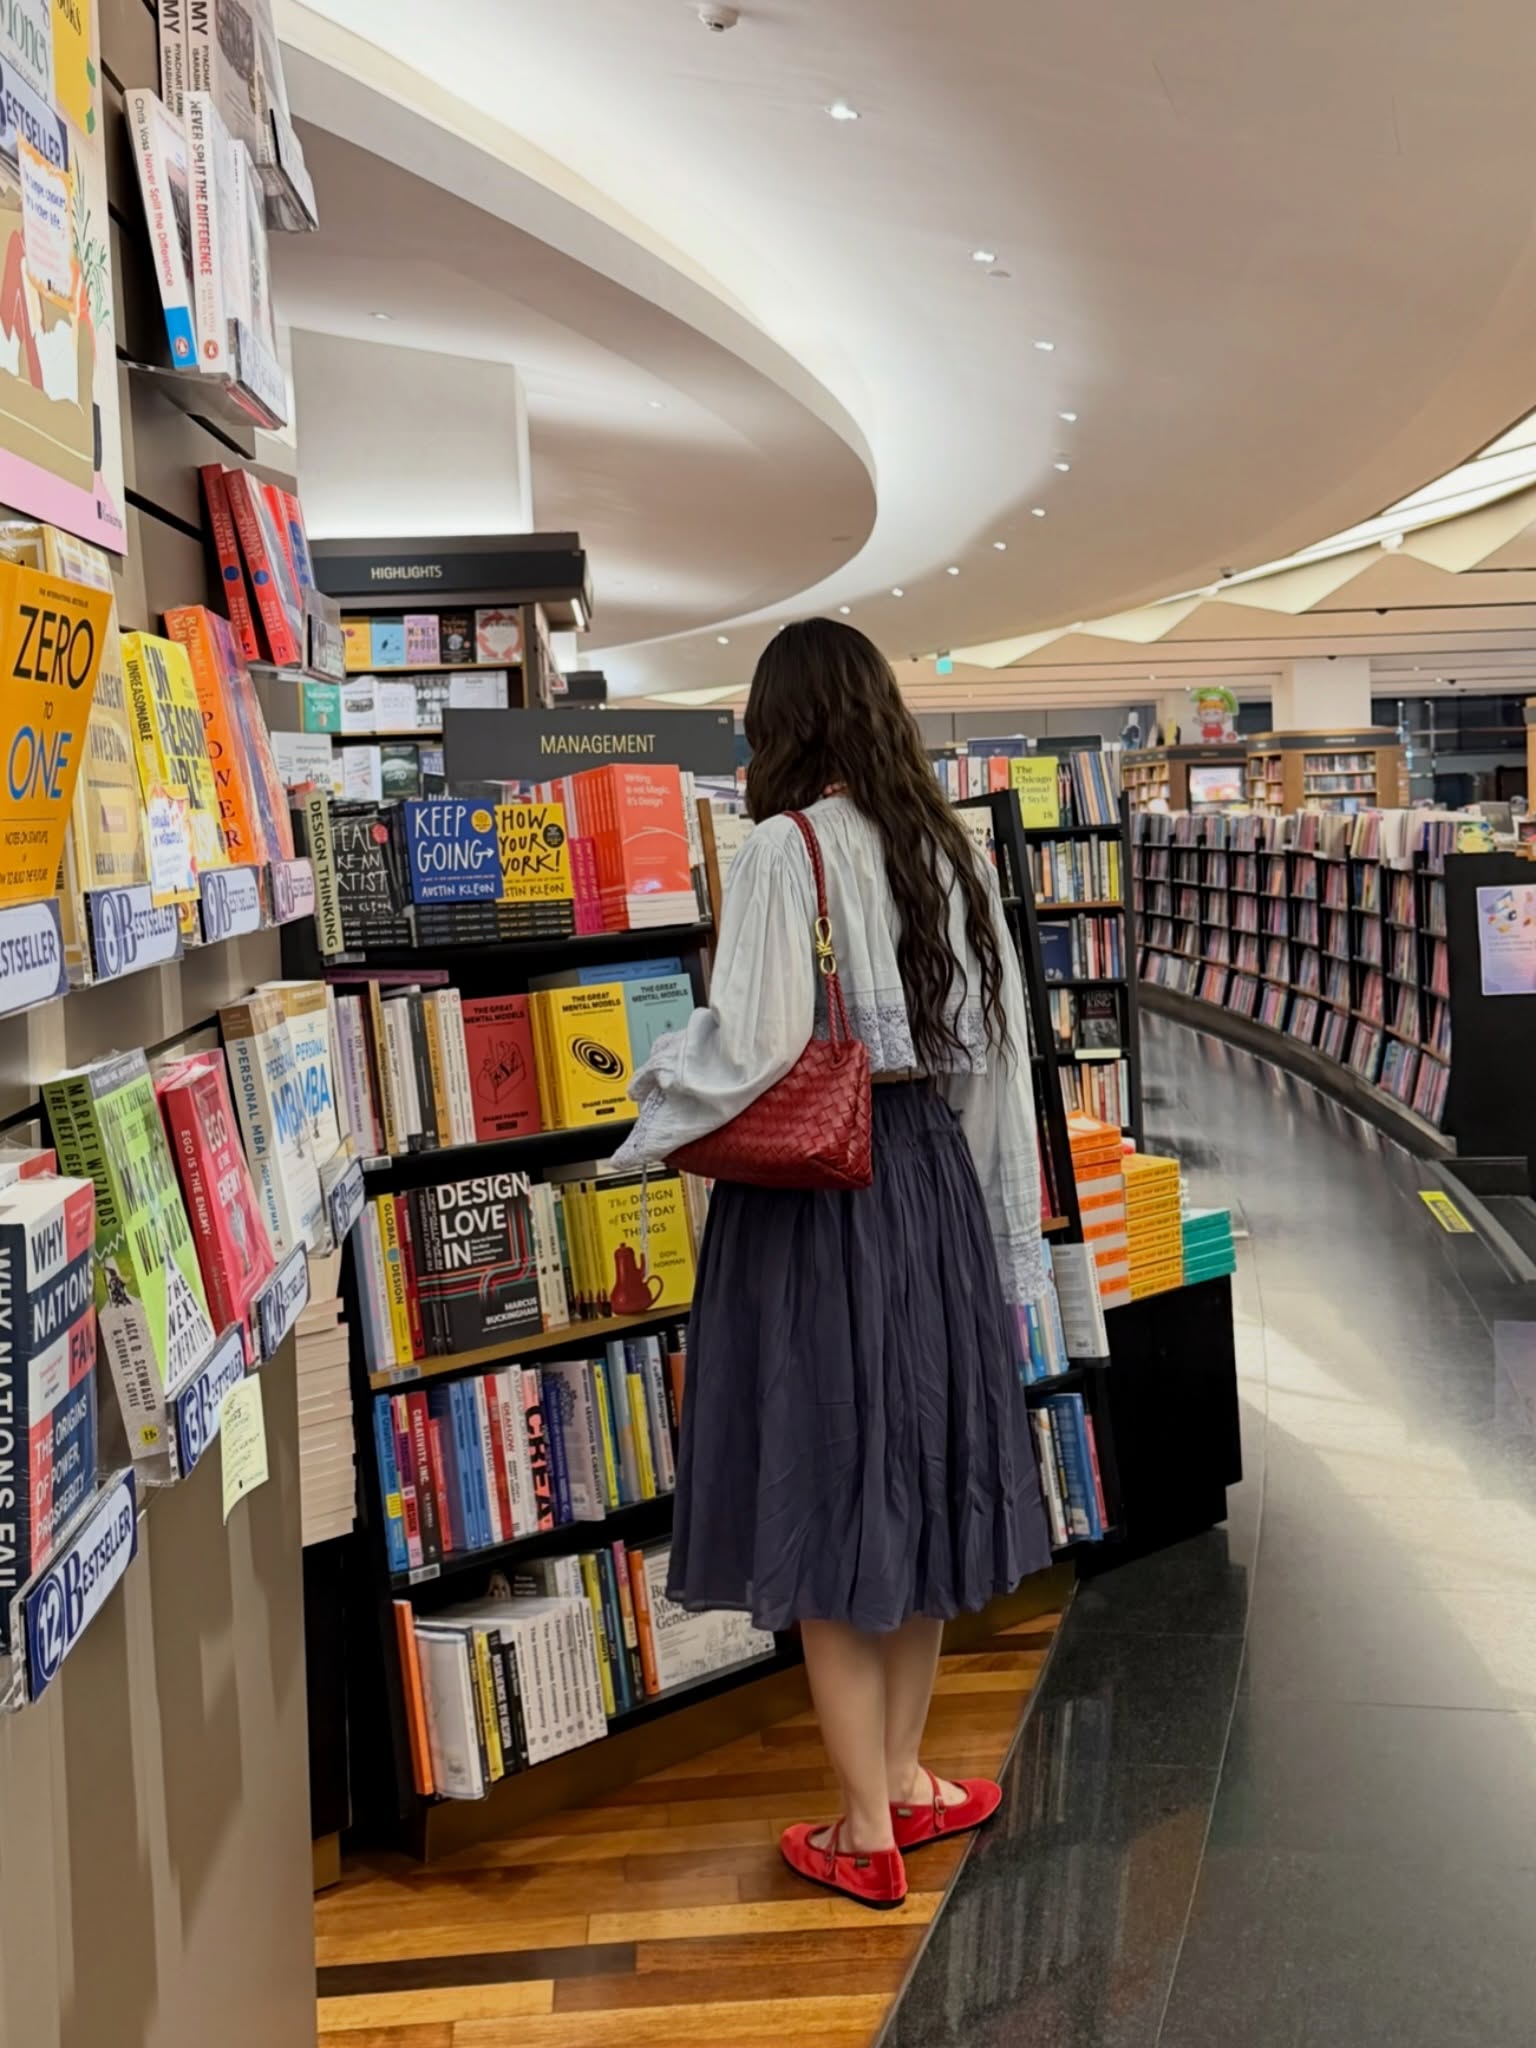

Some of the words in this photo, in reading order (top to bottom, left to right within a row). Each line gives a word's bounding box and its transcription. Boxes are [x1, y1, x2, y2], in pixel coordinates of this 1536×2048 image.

[135, 97, 146, 125] Chris
[189, 100, 205, 140] NEVER
[140, 127, 150, 151] Voss
[144, 153, 156, 181] Never
[193, 143, 208, 176] SPLIT
[150, 187, 161, 207] Split
[195, 178, 209, 201] THE
[153, 211, 164, 230] the
[195, 203, 214, 276] DIFFERENCE
[158, 232, 174, 287] Difference
[371, 564, 443, 581] HIGHLIGHTS
[13, 604, 94, 690] ZERO
[126, 660, 153, 742] UNREASONABLE
[541, 733, 657, 755] MANAGEMENT
[8, 725, 72, 801] ONE
[306, 769, 331, 785] data
[1015, 766, 1032, 774] The
[1016, 775, 1051, 786] Chicago
[310, 800, 328, 862] DESIGN
[415, 805, 467, 838] KEEP
[495, 808, 548, 831] HOW
[331, 823, 380, 852] TEAL
[499, 833, 548, 856] YOUR
[417, 840, 490, 873] GOING
[421, 884, 456, 898] AUSTIN
[459, 882, 495, 897] KLEON
[530, 883, 565, 896] KLEON
[318, 865, 338, 949] THINKING
[571, 995, 586, 1003] THE
[587, 991, 610, 1002] GREAT
[632, 993, 659, 1003] MENTAL
[660, 989, 689, 1000] MODELS
[640, 986, 654, 994] THE
[655, 982, 677, 993] GREAT
[464, 1014, 493, 1025] MENTAL
[495, 1011, 525, 1022] MODELS
[473, 1006, 488, 1014] THE
[489, 1003, 513, 1013] GREAT
[562, 1003, 590, 1013] MENTAL
[591, 999, 621, 1010] MODELS
[48, 1088, 68, 1112] THE
[237, 1046, 260, 1121] PERSONAL
[252, 1123, 266, 1155] MBA
[55, 1115, 77, 1149] NEXT
[181, 1129, 195, 1155] EGO
[205, 1109, 229, 1153] EGO
[65, 1082, 101, 1155] MARKET
[84, 1158, 119, 1228] WIZARDS
[187, 1156, 198, 1169] IS
[190, 1171, 203, 1194] THE
[261, 1163, 272, 1187] JOSH
[437, 1171, 530, 1211] DESIGN
[194, 1195, 212, 1236] ENEMY
[265, 1187, 280, 1232] KAUFMAN
[440, 1204, 508, 1240] LOVE
[620, 1204, 677, 1224] EVEYDAY
[32, 1216, 65, 1275] WHY
[383, 1203, 397, 1247] GLOBAL
[391, 1263, 404, 1305] DESIGN
[443, 1240, 473, 1270] IN
[659, 1250, 678, 1259] DON
[653, 1257, 686, 1268] NORMAN
[33, 1257, 95, 1344] NATIONS
[168, 1273, 190, 1307] THE
[504, 1296, 538, 1311] MARCUS
[168, 1293, 200, 1341] NEXT
[485, 1306, 539, 1325] BUCKINGHAM
[124, 1317, 140, 1341] JACK
[134, 1359, 157, 1412] SCHWAGER
[35, 1425, 54, 1465] THE
[54, 1395, 88, 1444] ORIGINS
[410, 1409, 428, 1465] CREATIVITY,
[481, 1425, 495, 1473] STRATEGIC
[36, 1473, 53, 1504] OF
[418, 1465, 430, 1486] INC.
[38, 1586, 62, 1671] 12
[61, 1504, 132, 1650] BESTSELLER
